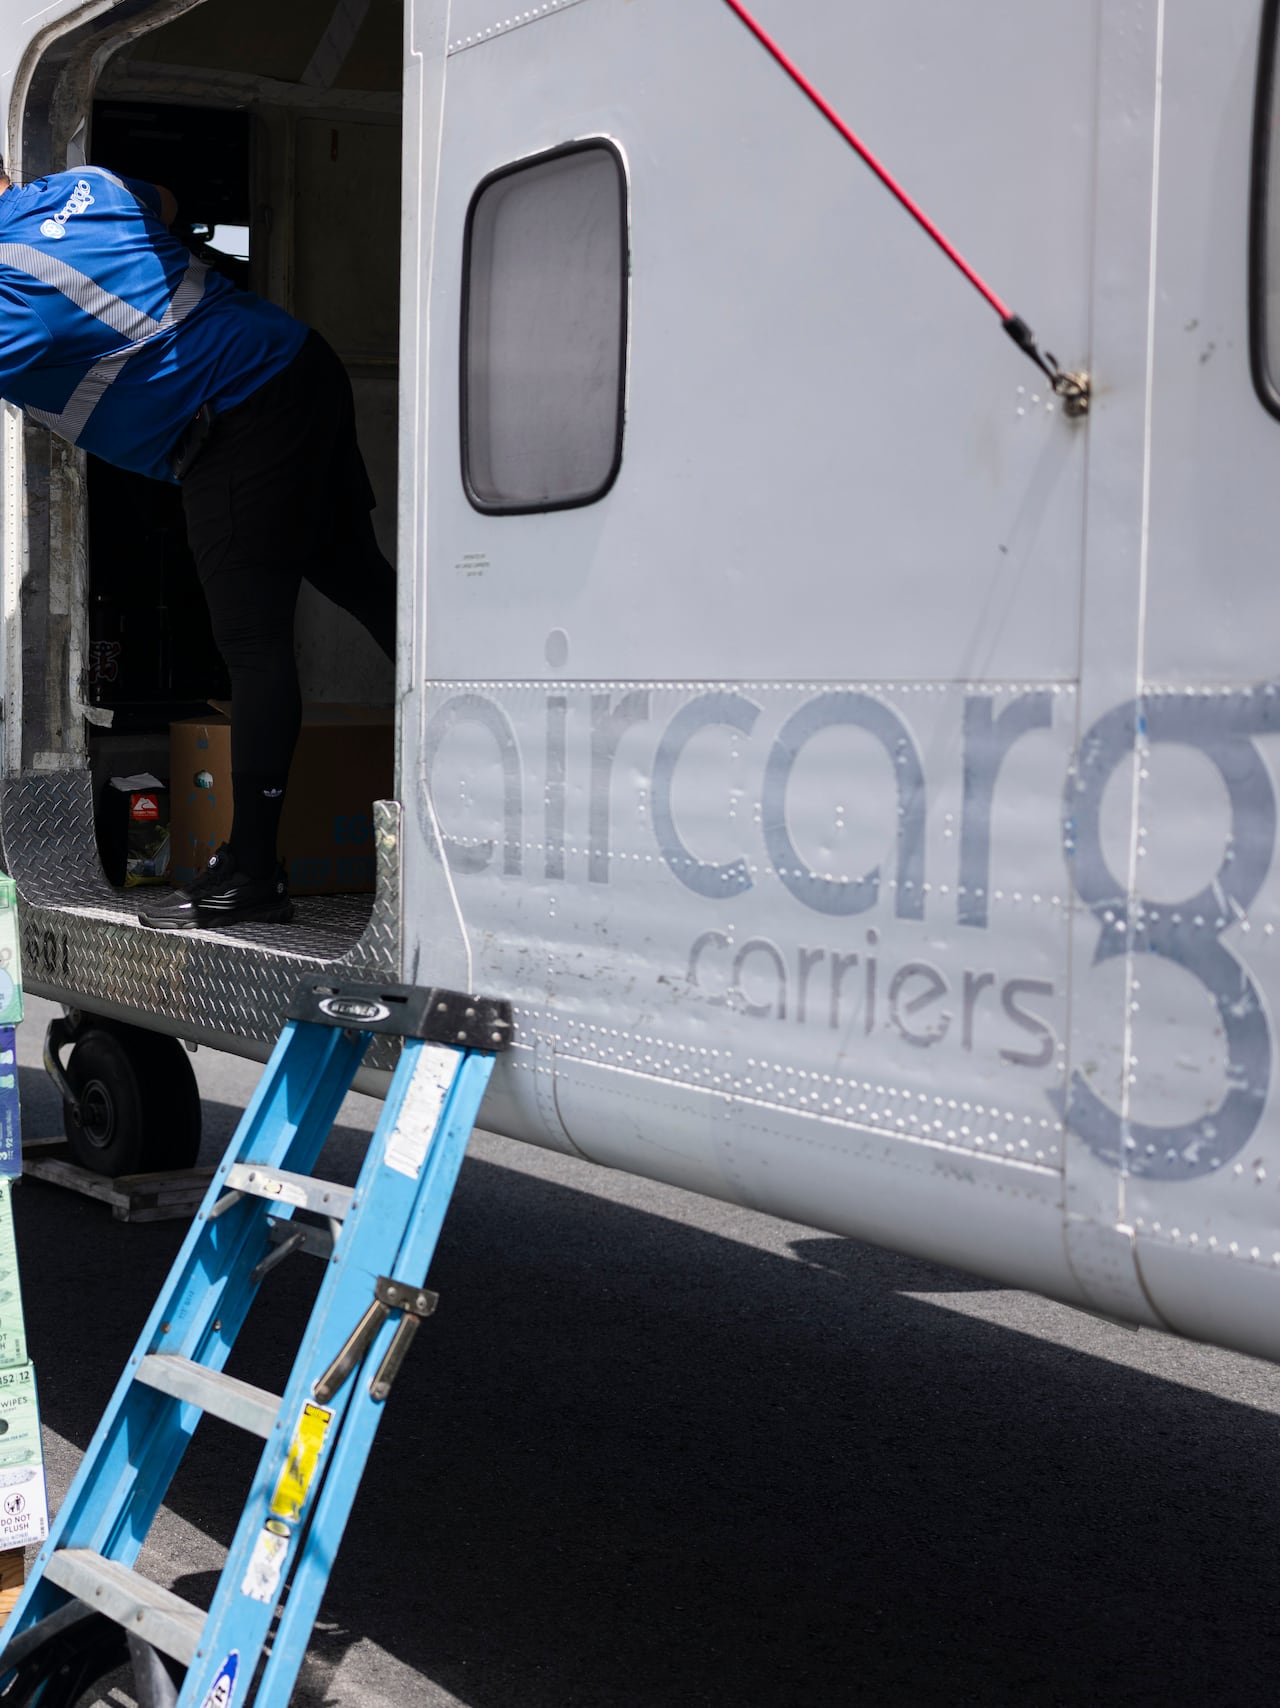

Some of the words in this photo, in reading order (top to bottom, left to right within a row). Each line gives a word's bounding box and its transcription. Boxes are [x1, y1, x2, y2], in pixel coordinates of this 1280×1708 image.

[54, 180, 95, 224] cargo
[686, 926, 1056, 1070] carriers
[19, 1371, 30, 1381] 12
[0, 1396, 28, 1408] WIPES
[0, 1517, 12, 1527] DO
[14, 1513, 31, 1524] NOT
[4, 1523, 29, 1534] FLUSH
